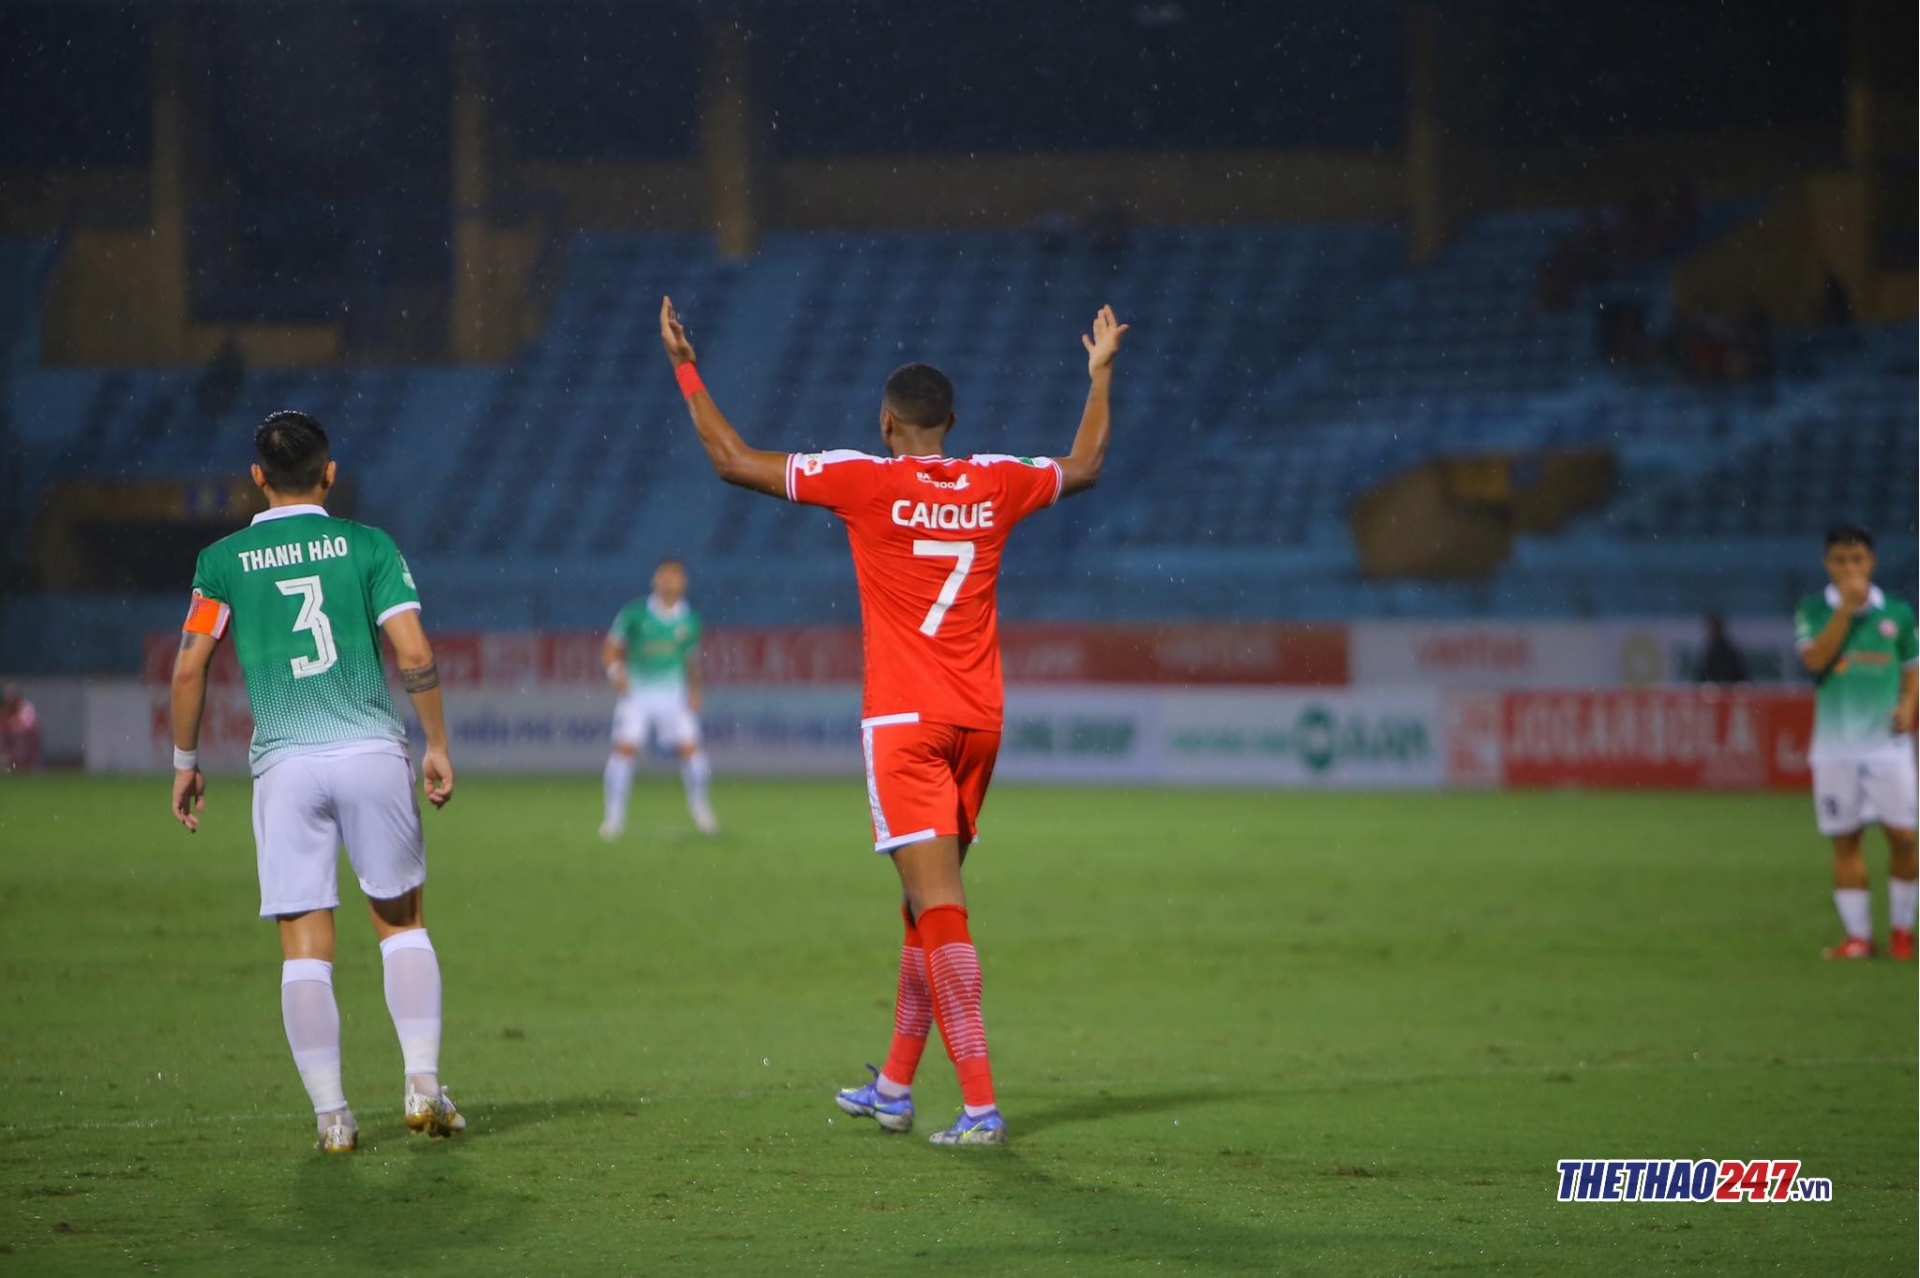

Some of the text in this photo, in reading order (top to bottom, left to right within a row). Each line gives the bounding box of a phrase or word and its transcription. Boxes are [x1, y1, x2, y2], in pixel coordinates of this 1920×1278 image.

[891, 499, 995, 530] CAIQUE
[238, 534, 348, 573] THANH HÀO
[912, 539, 975, 637] 7
[274, 575, 339, 680] 3
